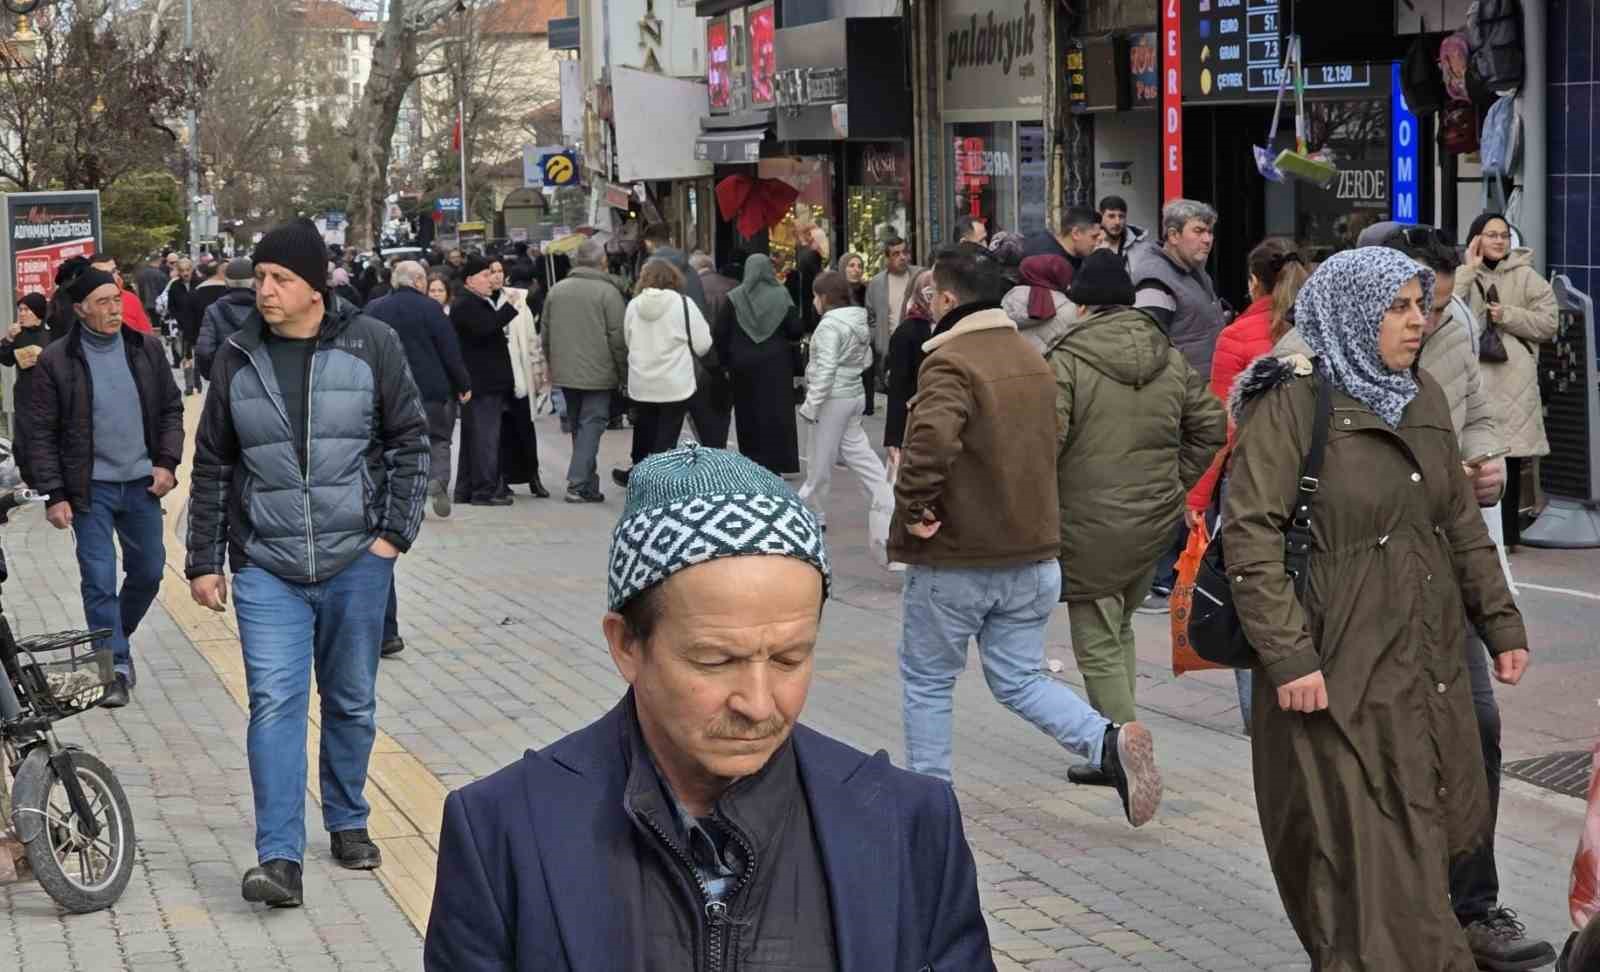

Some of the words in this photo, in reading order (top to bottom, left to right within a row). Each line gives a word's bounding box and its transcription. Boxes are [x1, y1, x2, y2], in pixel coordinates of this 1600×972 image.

[1219, 19, 1239, 33] EURO
[1219, 45, 1240, 60] GRAM
[1167, 0, 1178, 171] ZERDE
[1216, 72, 1243, 91] ÇEYREK
[1322, 66, 1353, 83] 12.150
[1336, 170, 1385, 199] ZERDE
